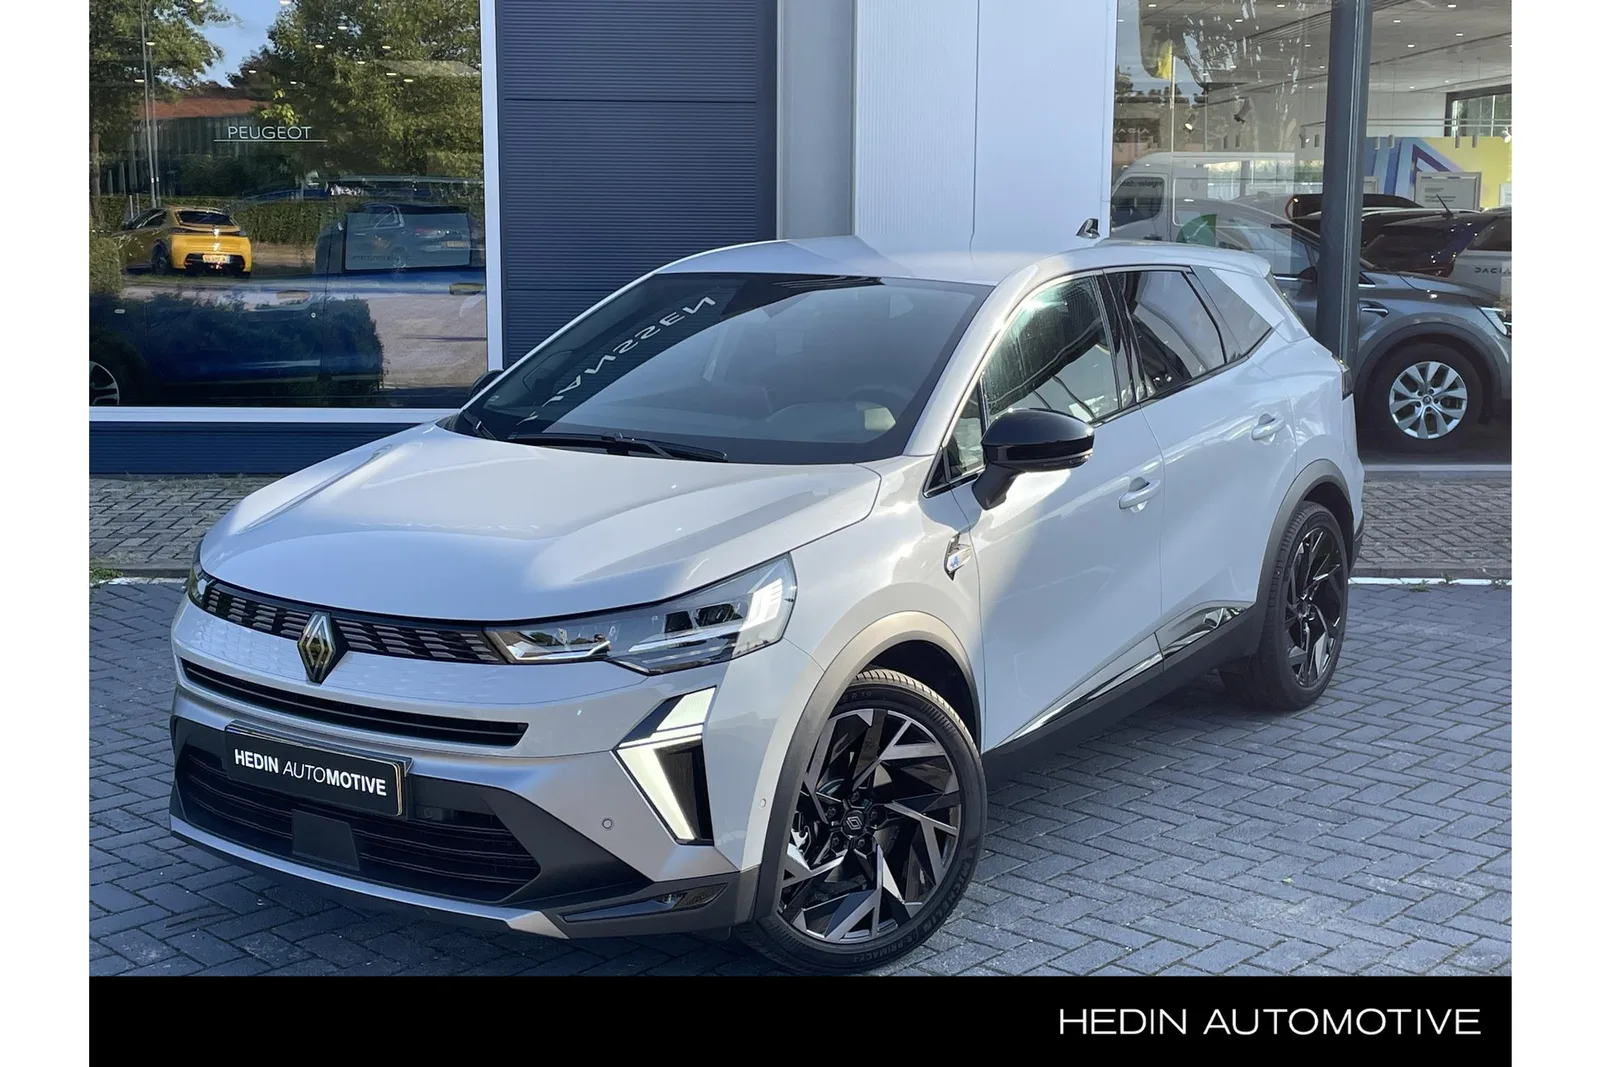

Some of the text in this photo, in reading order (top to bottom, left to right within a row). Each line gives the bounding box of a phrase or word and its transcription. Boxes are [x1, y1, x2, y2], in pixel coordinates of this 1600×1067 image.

[227, 126, 312, 140] PEUGEOT
[234, 748, 387, 797] HEDIN AUTOMOTIVE
